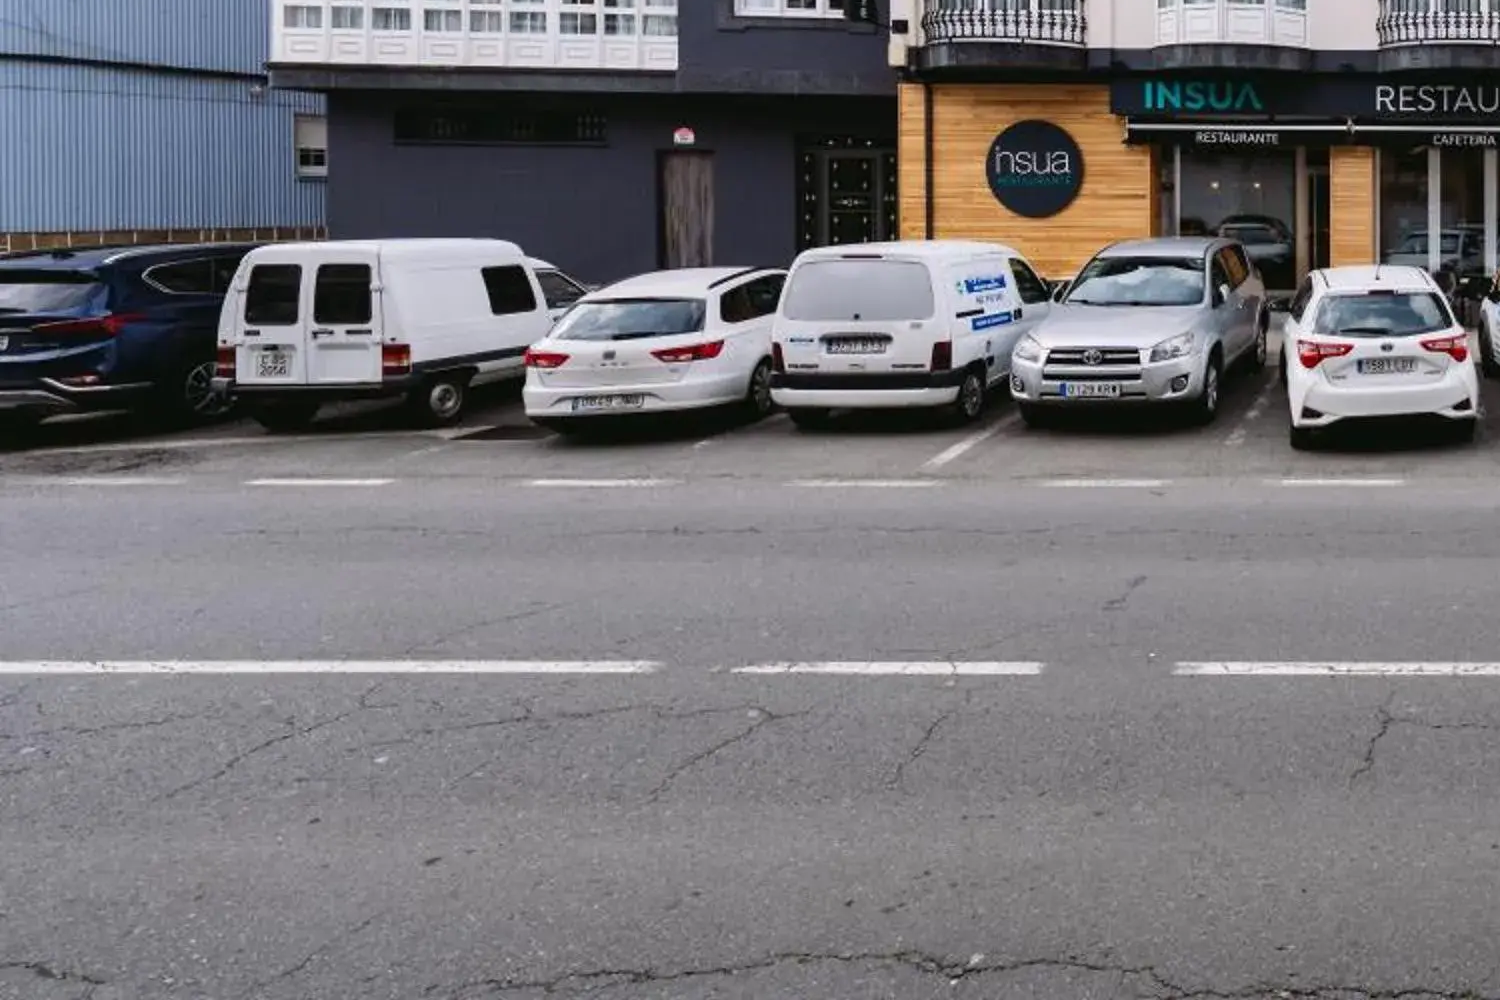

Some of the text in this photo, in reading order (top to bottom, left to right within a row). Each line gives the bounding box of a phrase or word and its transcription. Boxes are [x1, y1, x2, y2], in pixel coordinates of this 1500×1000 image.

[1144, 81, 1263, 110] INSUA
[1195, 131, 1279, 145] RESTAURANTE
[994, 145, 1071, 175] insua
